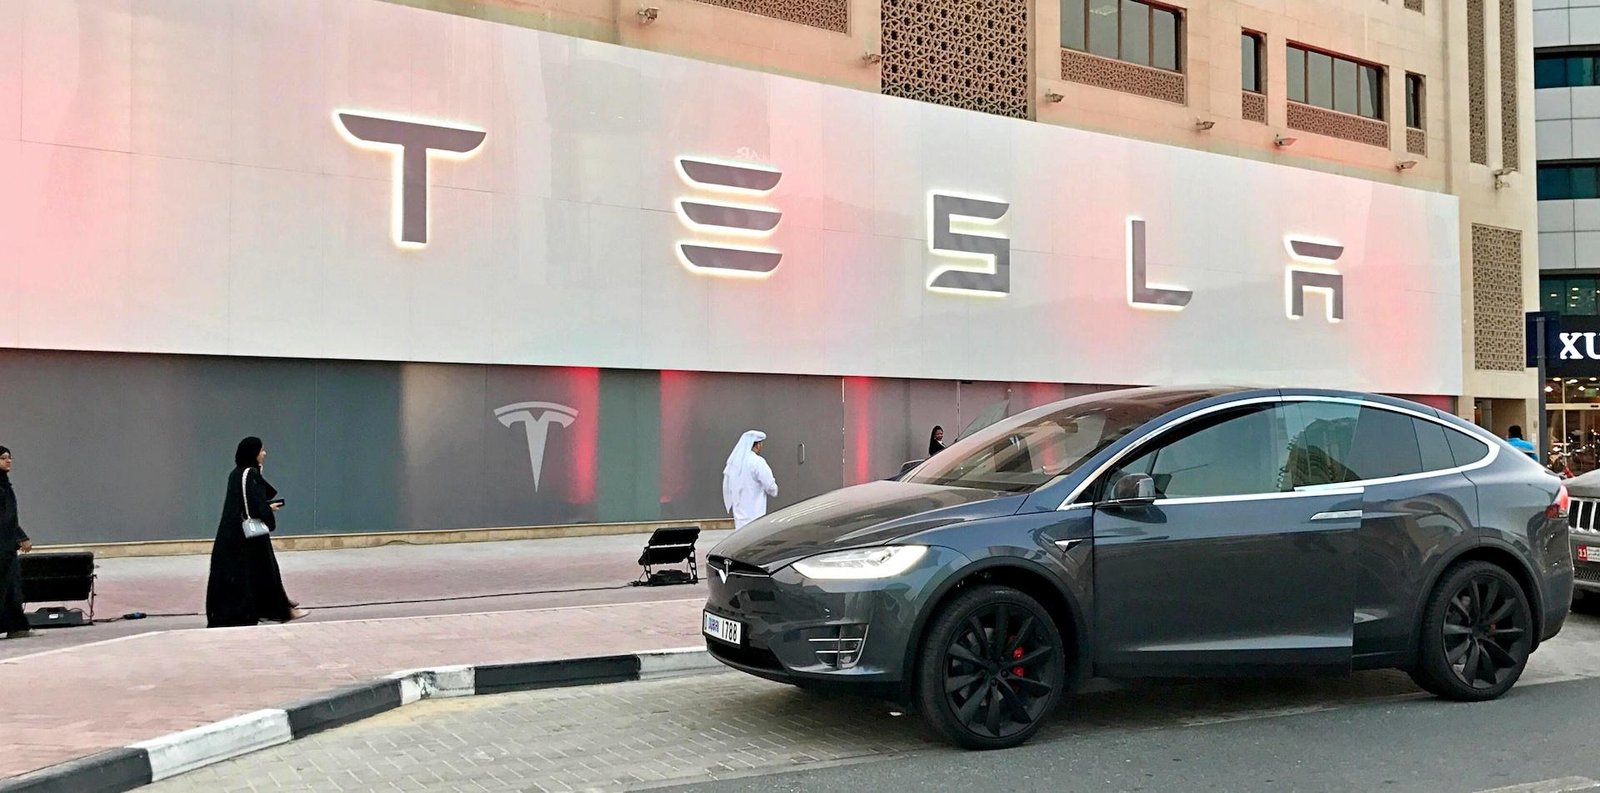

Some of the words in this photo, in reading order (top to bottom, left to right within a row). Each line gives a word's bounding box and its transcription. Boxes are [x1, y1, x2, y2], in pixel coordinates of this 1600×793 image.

[337, 112, 1344, 320] TESLA
[1558, 331, 1600, 360] XU
[722, 620, 738, 642] 1788
